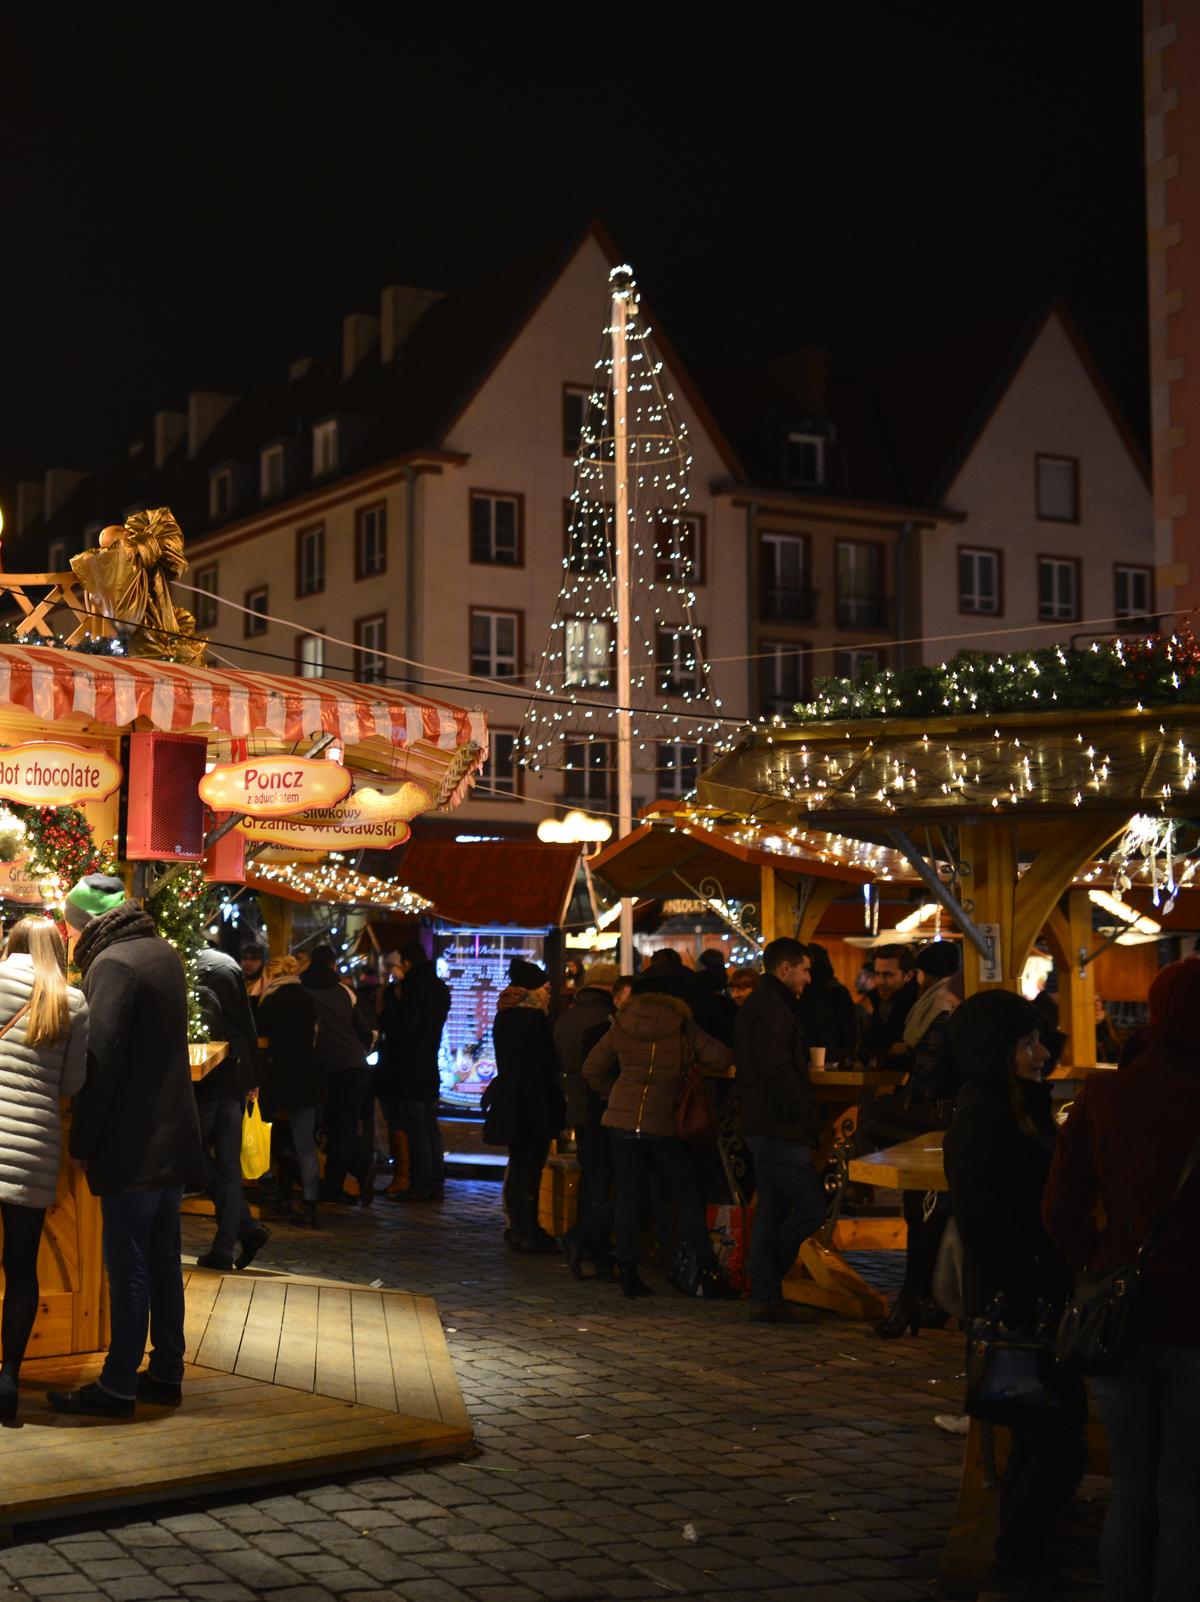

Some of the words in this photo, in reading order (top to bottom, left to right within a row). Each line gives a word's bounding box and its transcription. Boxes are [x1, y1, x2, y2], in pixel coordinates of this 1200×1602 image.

[25, 762, 100, 788] chocolate
[244, 769, 304, 790] Poncz
[247, 795, 252, 805] z
